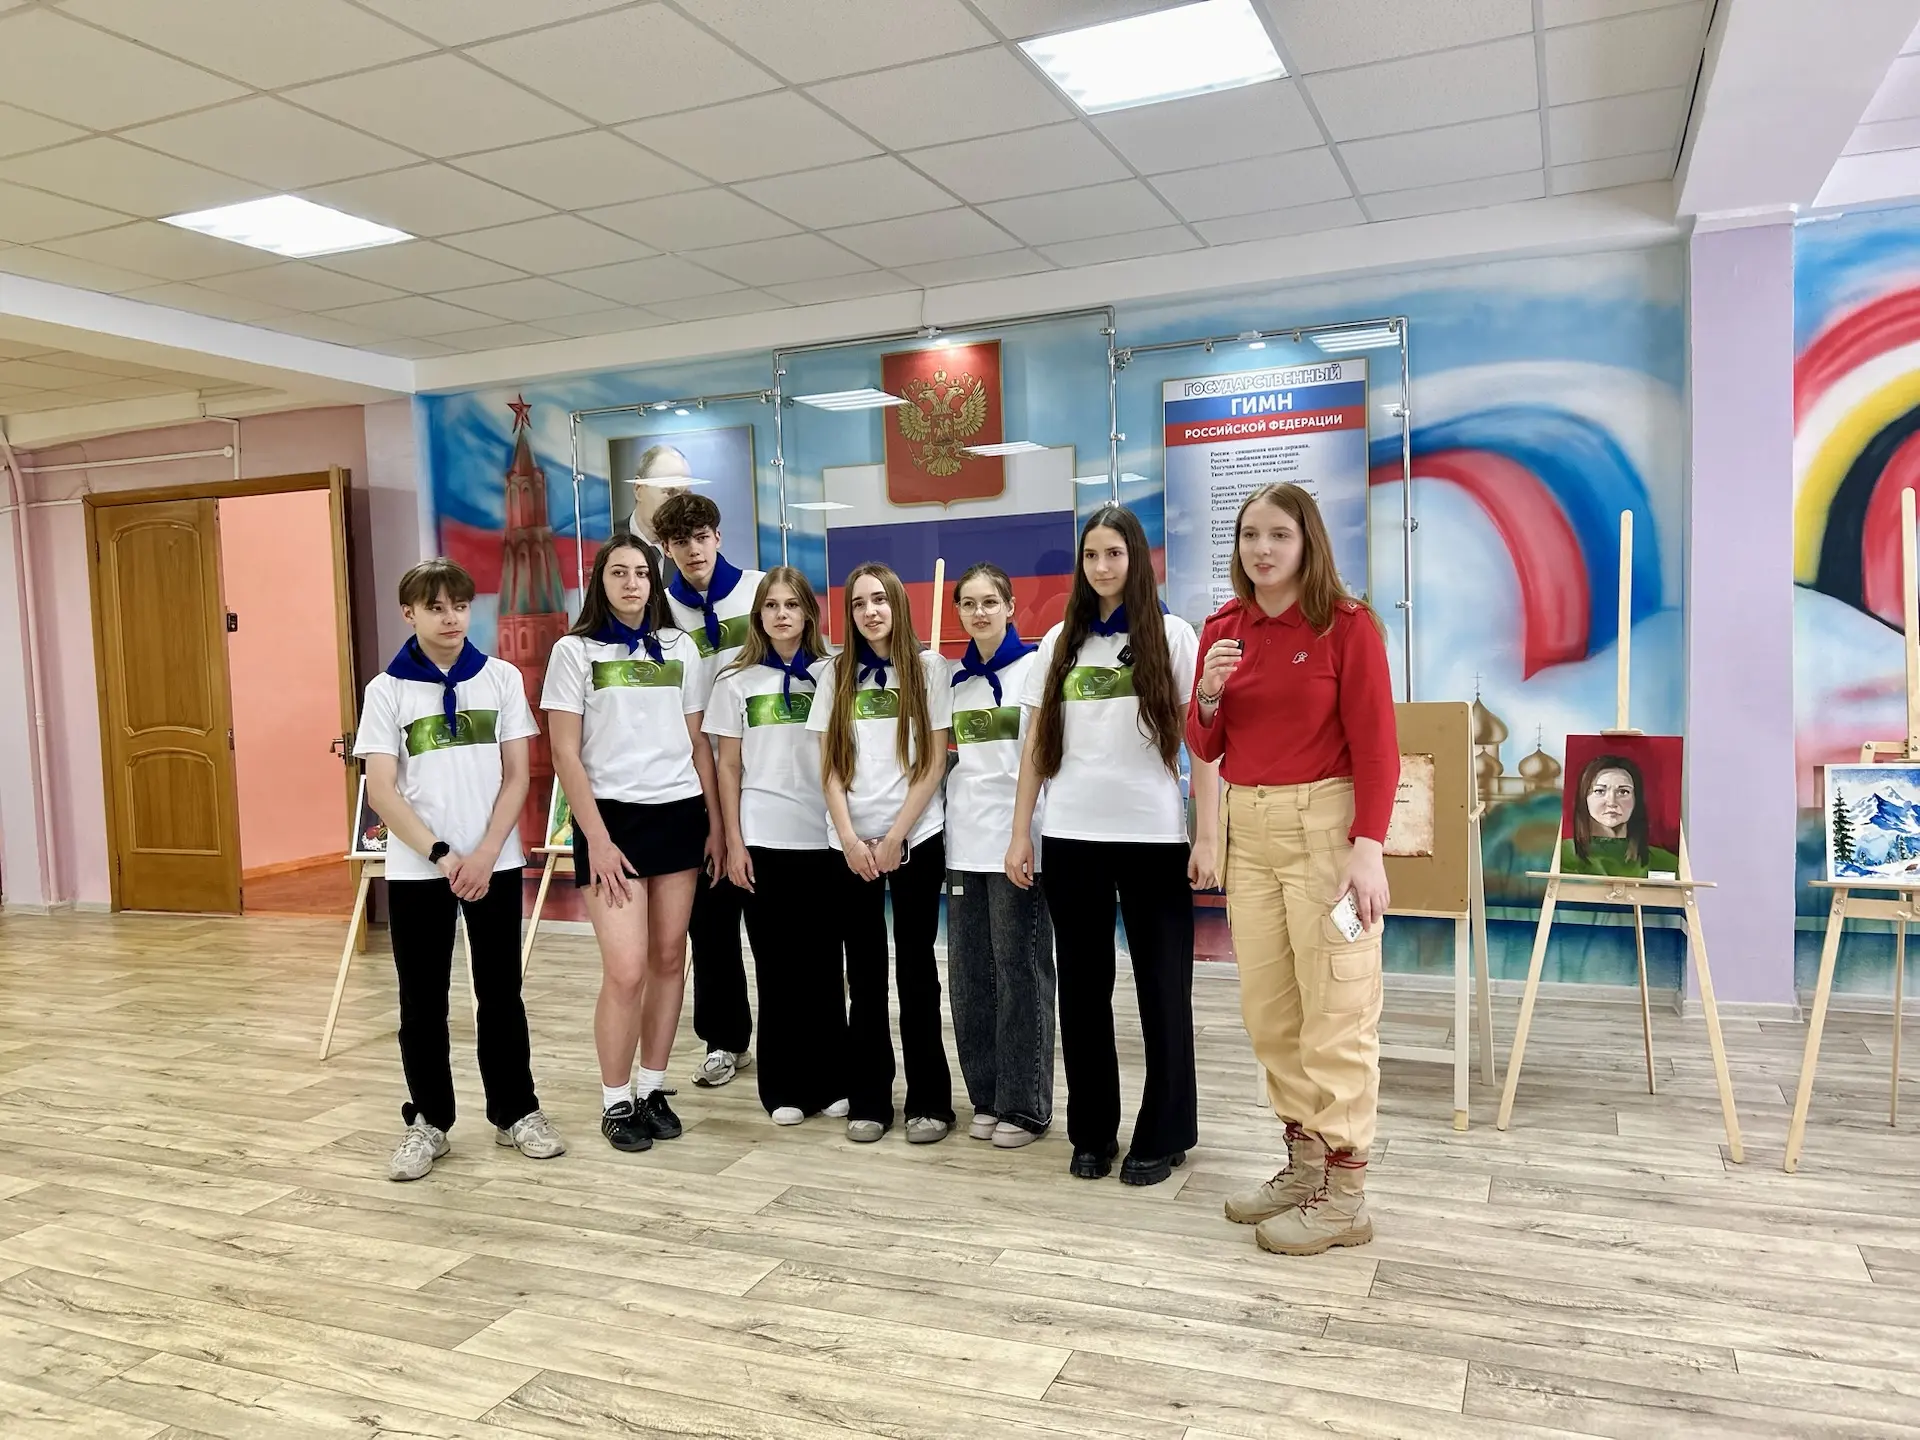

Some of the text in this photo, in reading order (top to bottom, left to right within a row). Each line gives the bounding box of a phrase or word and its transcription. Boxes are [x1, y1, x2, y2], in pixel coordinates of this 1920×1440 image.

[1184, 363, 1342, 396] ГОСУДАРСТВЕННЫЙ
[1231, 392, 1293, 416] ГИМН
[1185, 414, 1344, 439] РОССИЙСКОЙ ФЕДЕРАЦИИ
